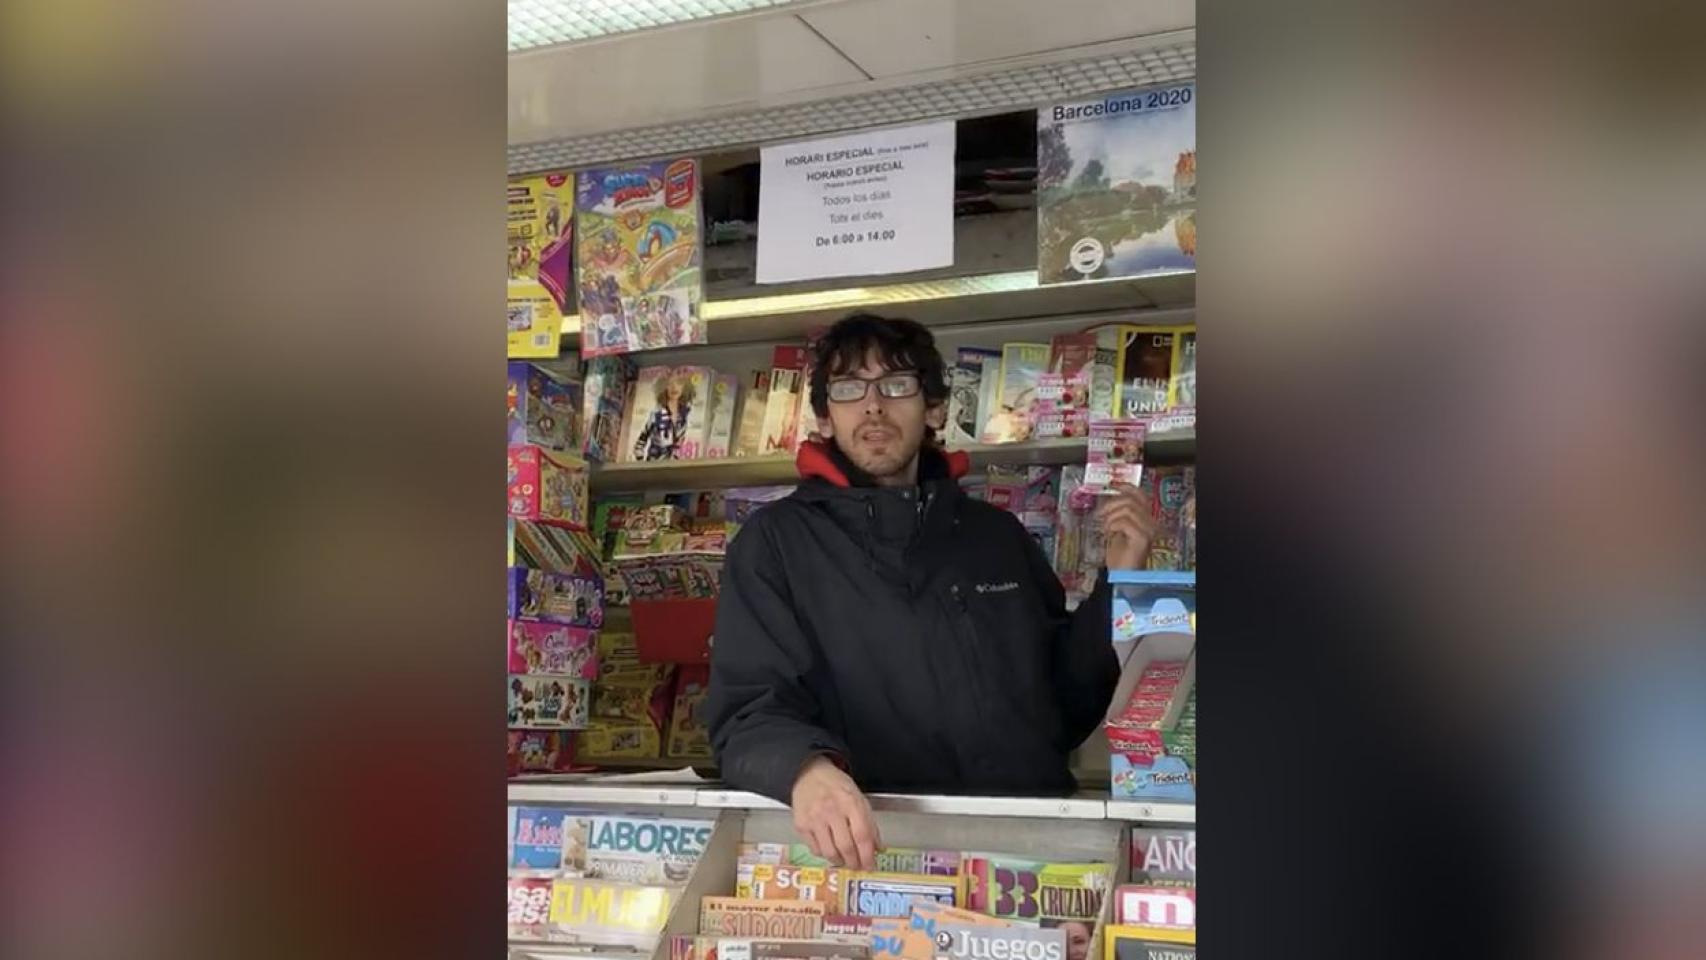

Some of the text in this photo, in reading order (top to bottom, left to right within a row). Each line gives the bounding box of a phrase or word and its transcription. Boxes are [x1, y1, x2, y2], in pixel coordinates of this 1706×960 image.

[1053, 97, 1142, 122] Barcelona
[1148, 88, 1192, 108] 2020
[785, 152, 824, 167] HORARI
[826, 147, 875, 162] ESPECIAL
[807, 160, 904, 182] HORARIO ESPECIAL
[822, 195, 851, 206] Todos
[853, 192, 868, 202] los
[863, 211, 884, 220] dies
[816, 236, 830, 247] De
[857, 234, 864, 242] a
[1151, 612, 1188, 625] Trident
[1152, 772, 1189, 785] Trident
[588, 820, 712, 855] LABORES
[722, 914, 816, 938] SUDOKU
[953, 930, 1061, 960] Juegos
